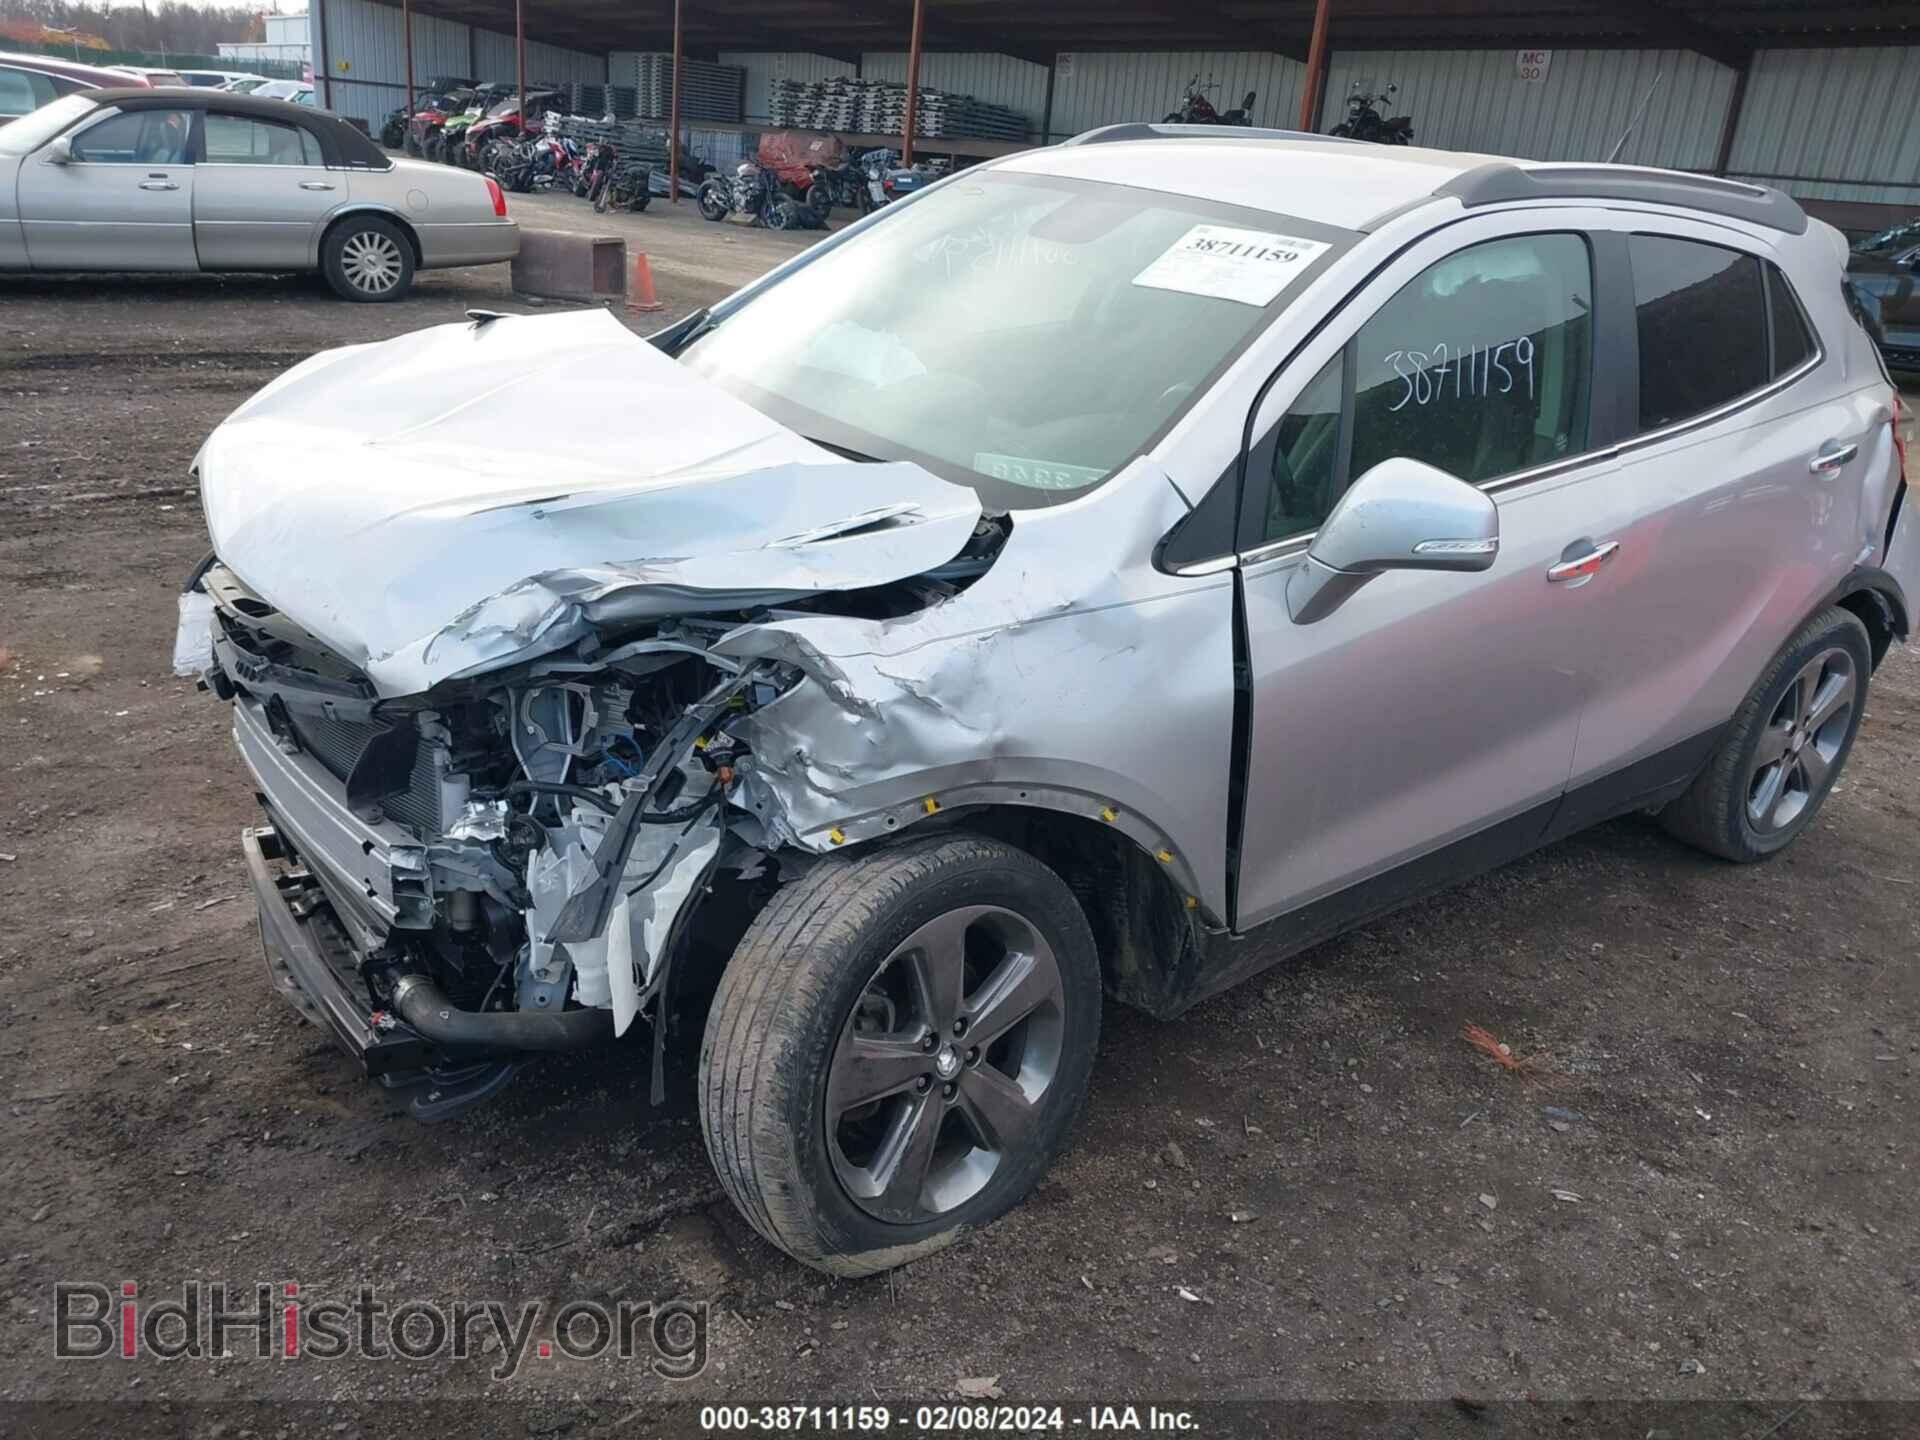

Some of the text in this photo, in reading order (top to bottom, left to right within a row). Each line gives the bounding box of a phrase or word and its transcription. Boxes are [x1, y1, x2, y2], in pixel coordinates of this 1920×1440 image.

[1522, 52, 1545, 64] MC
[1521, 67, 1540, 80] 30
[1186, 238, 1299, 264] 38711159
[1384, 336, 1534, 411] 38711159
